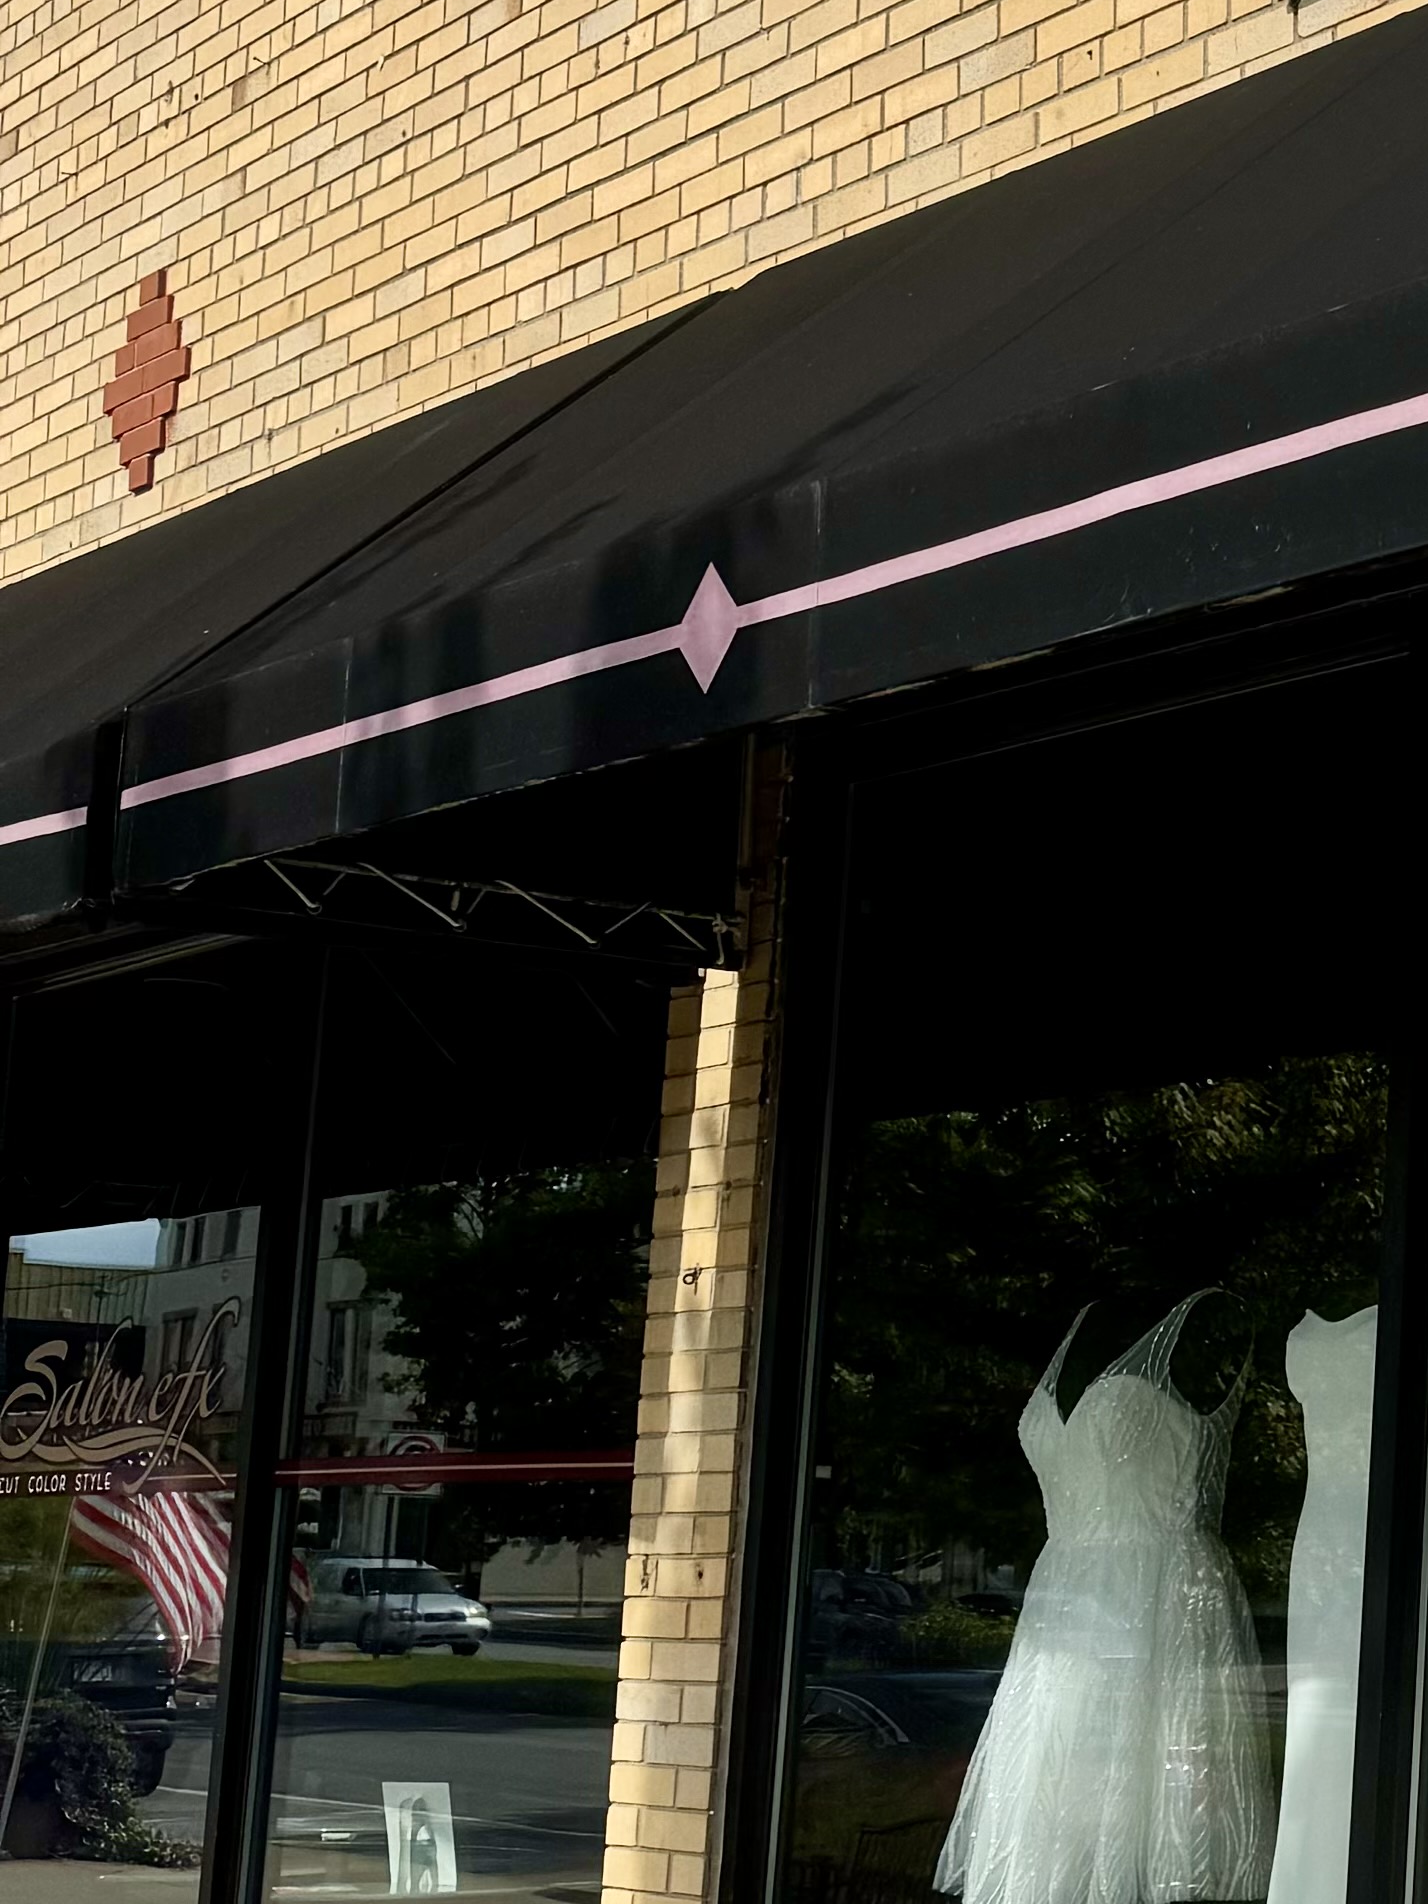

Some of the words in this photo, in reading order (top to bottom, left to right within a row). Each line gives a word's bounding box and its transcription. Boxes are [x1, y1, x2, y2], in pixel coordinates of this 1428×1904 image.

[0, 1315, 146, 1460] Salon
[28, 1474, 67, 1493] COLOR
[75, 1471, 113, 1492] STYLE
